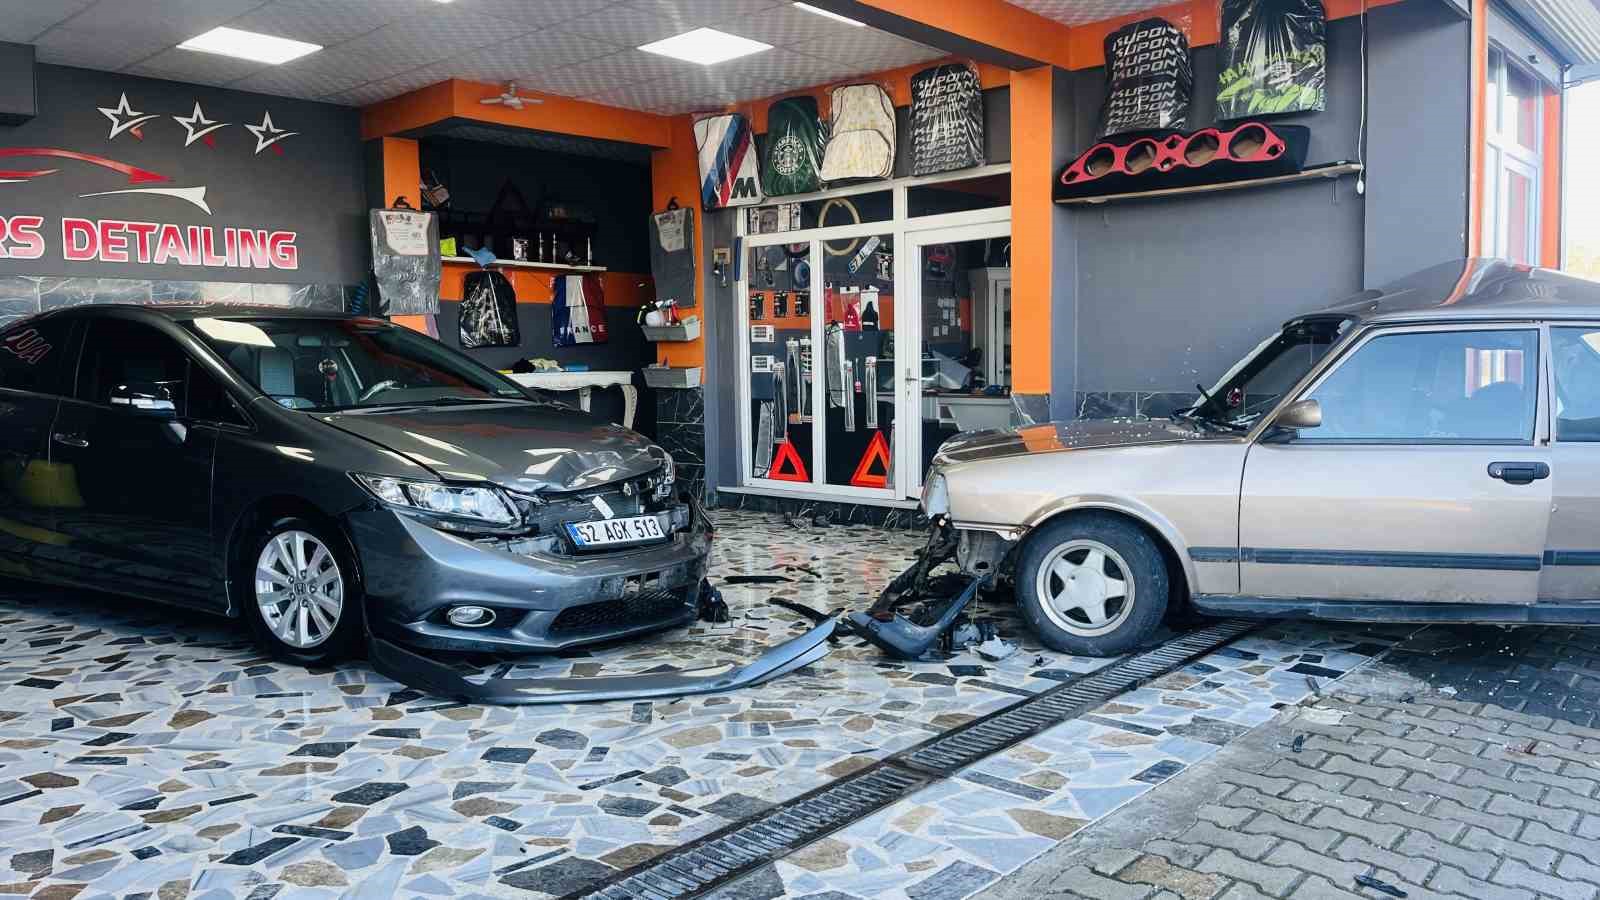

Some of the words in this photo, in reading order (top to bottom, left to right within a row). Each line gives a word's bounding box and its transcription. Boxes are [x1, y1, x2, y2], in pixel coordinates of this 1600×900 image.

[1112, 47, 1176, 70] KUPON
[1112, 57, 1178, 81] KUPON
[1110, 89, 1176, 108] KUPON
[1111, 80, 1177, 99] KUPON
[1108, 99, 1176, 117] KUPON
[731, 177, 758, 198] M
[0, 215, 45, 259] S
[62, 217, 298, 270] DETAILING
[577, 524, 600, 542] 52
[604, 520, 633, 541] AGK
[634, 518, 659, 538] 513
